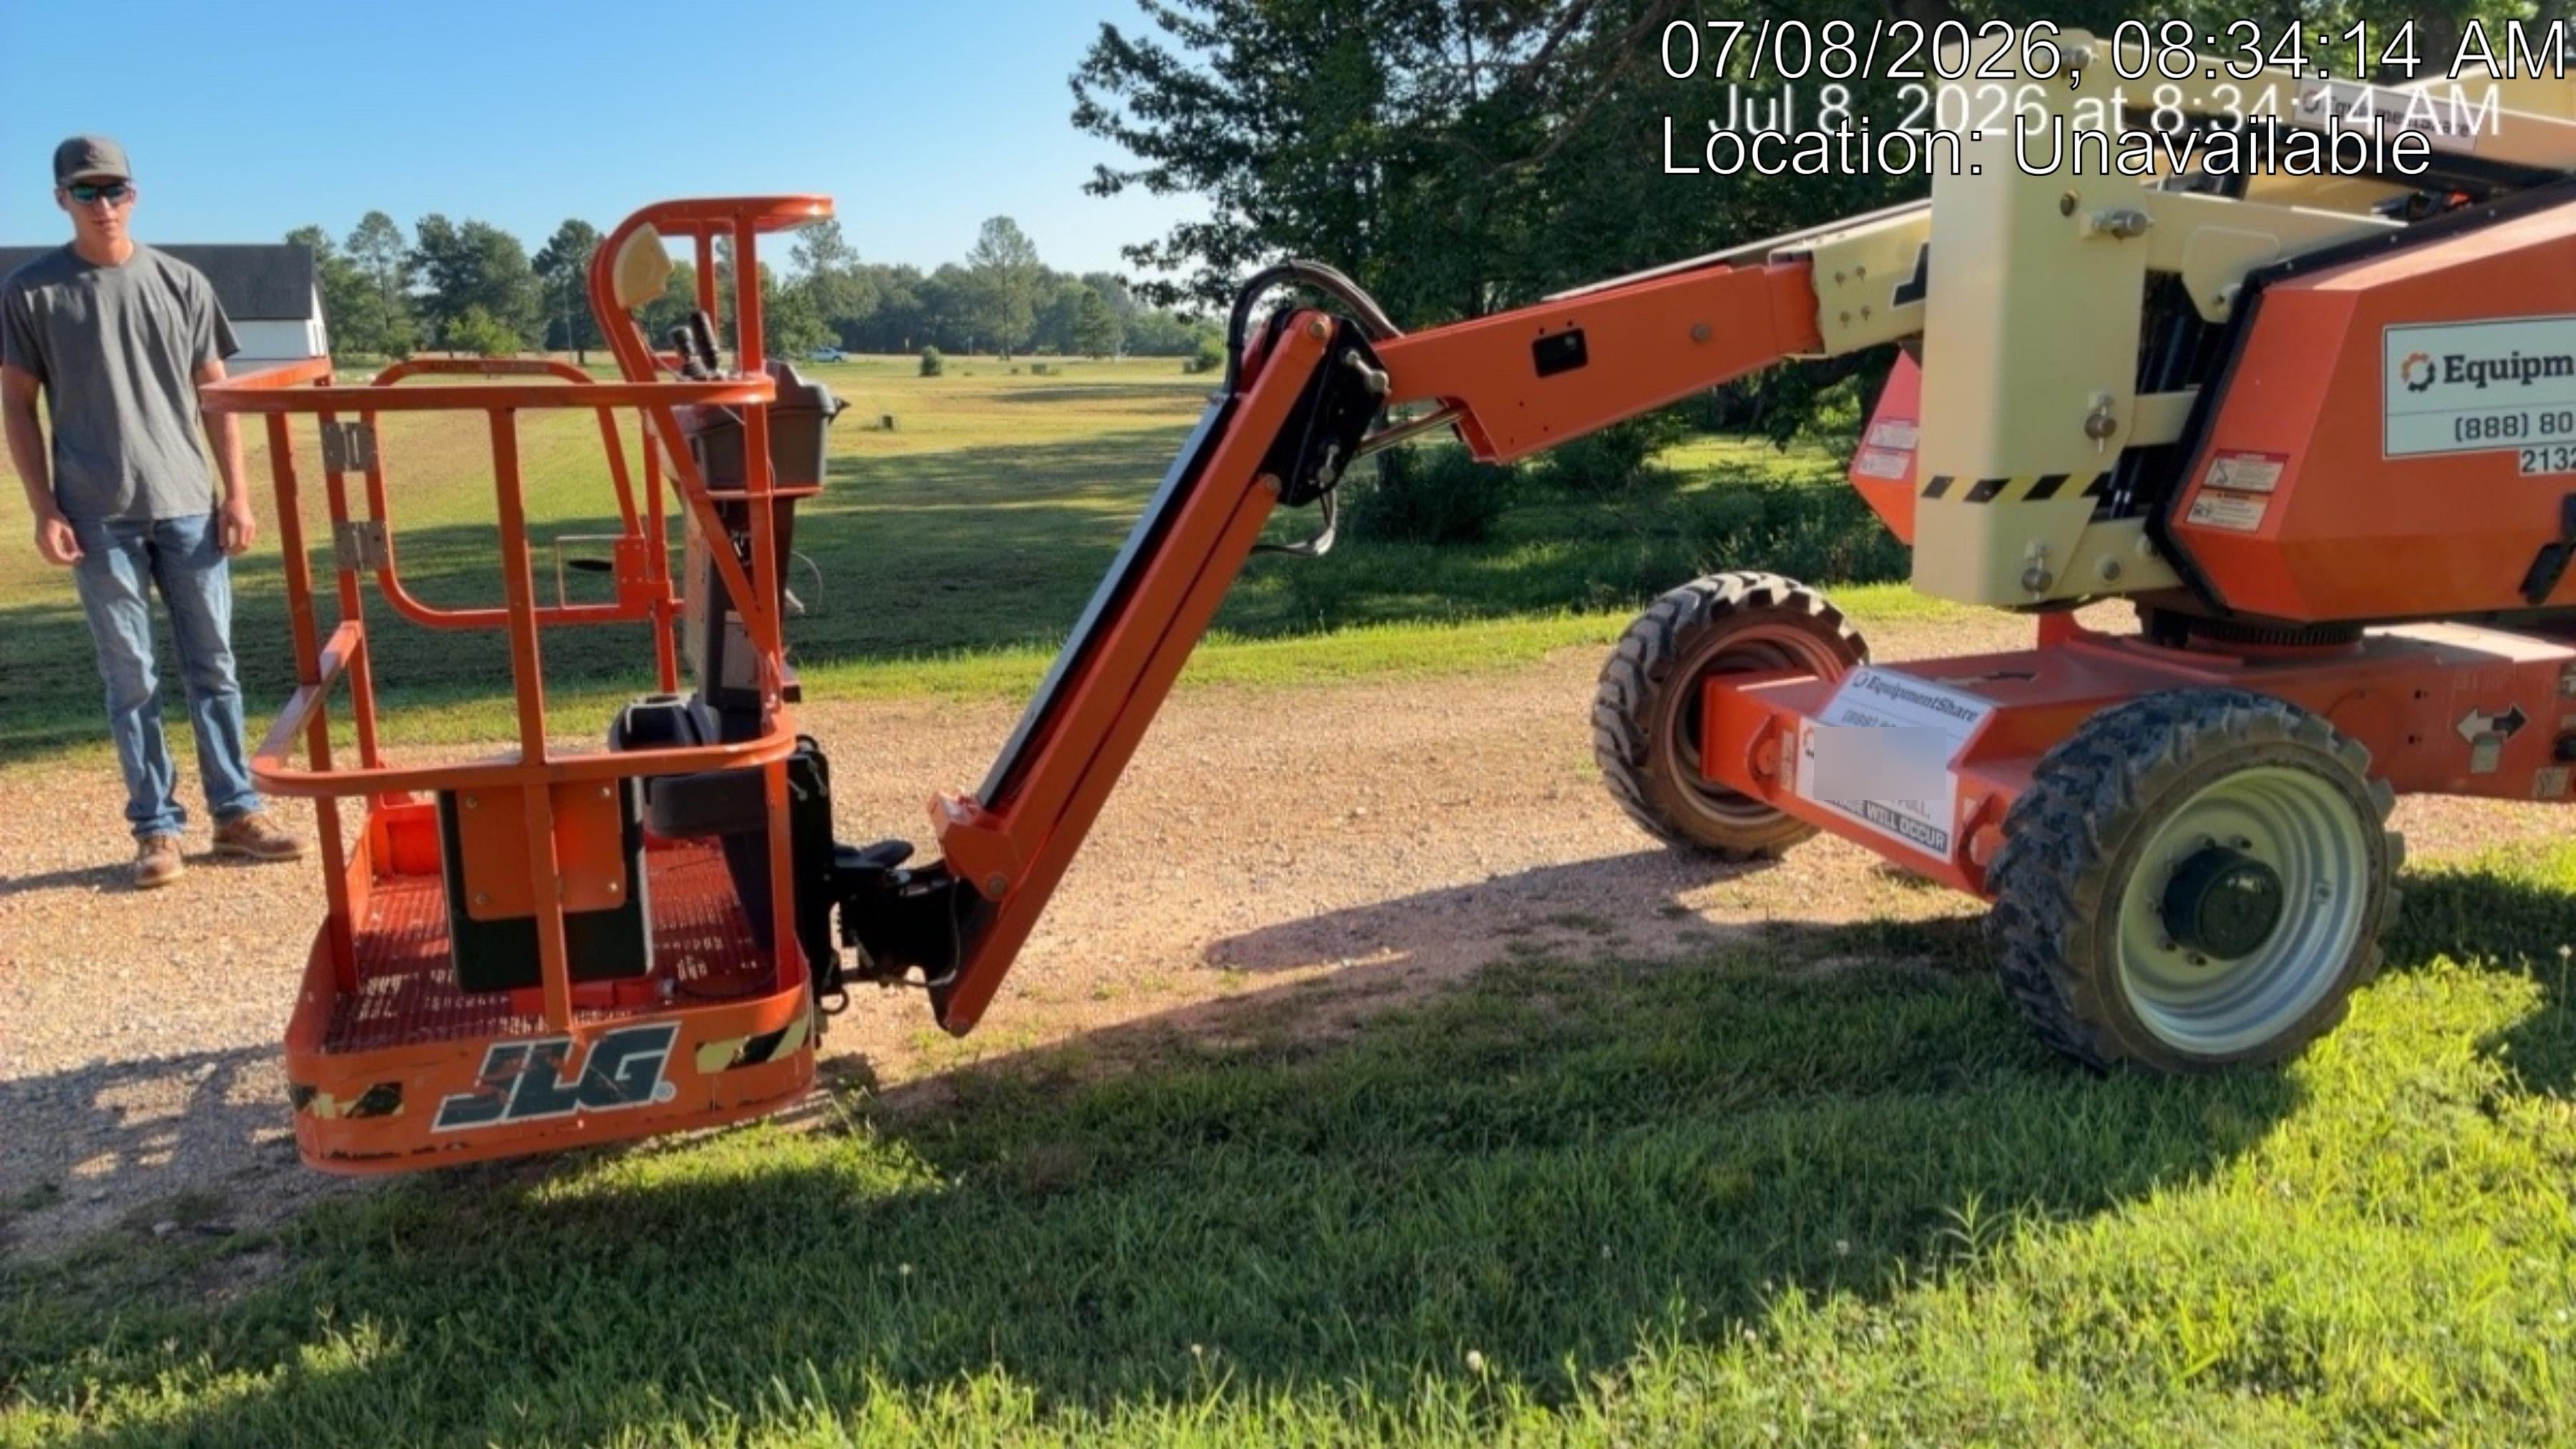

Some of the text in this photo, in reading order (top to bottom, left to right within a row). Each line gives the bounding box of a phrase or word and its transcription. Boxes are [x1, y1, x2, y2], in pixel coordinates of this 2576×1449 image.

[2455, 411, 2573, 442] (888) 80
[1899, 817, 1945, 849] OCCUR
[431, 1021, 683, 1132] JLG
